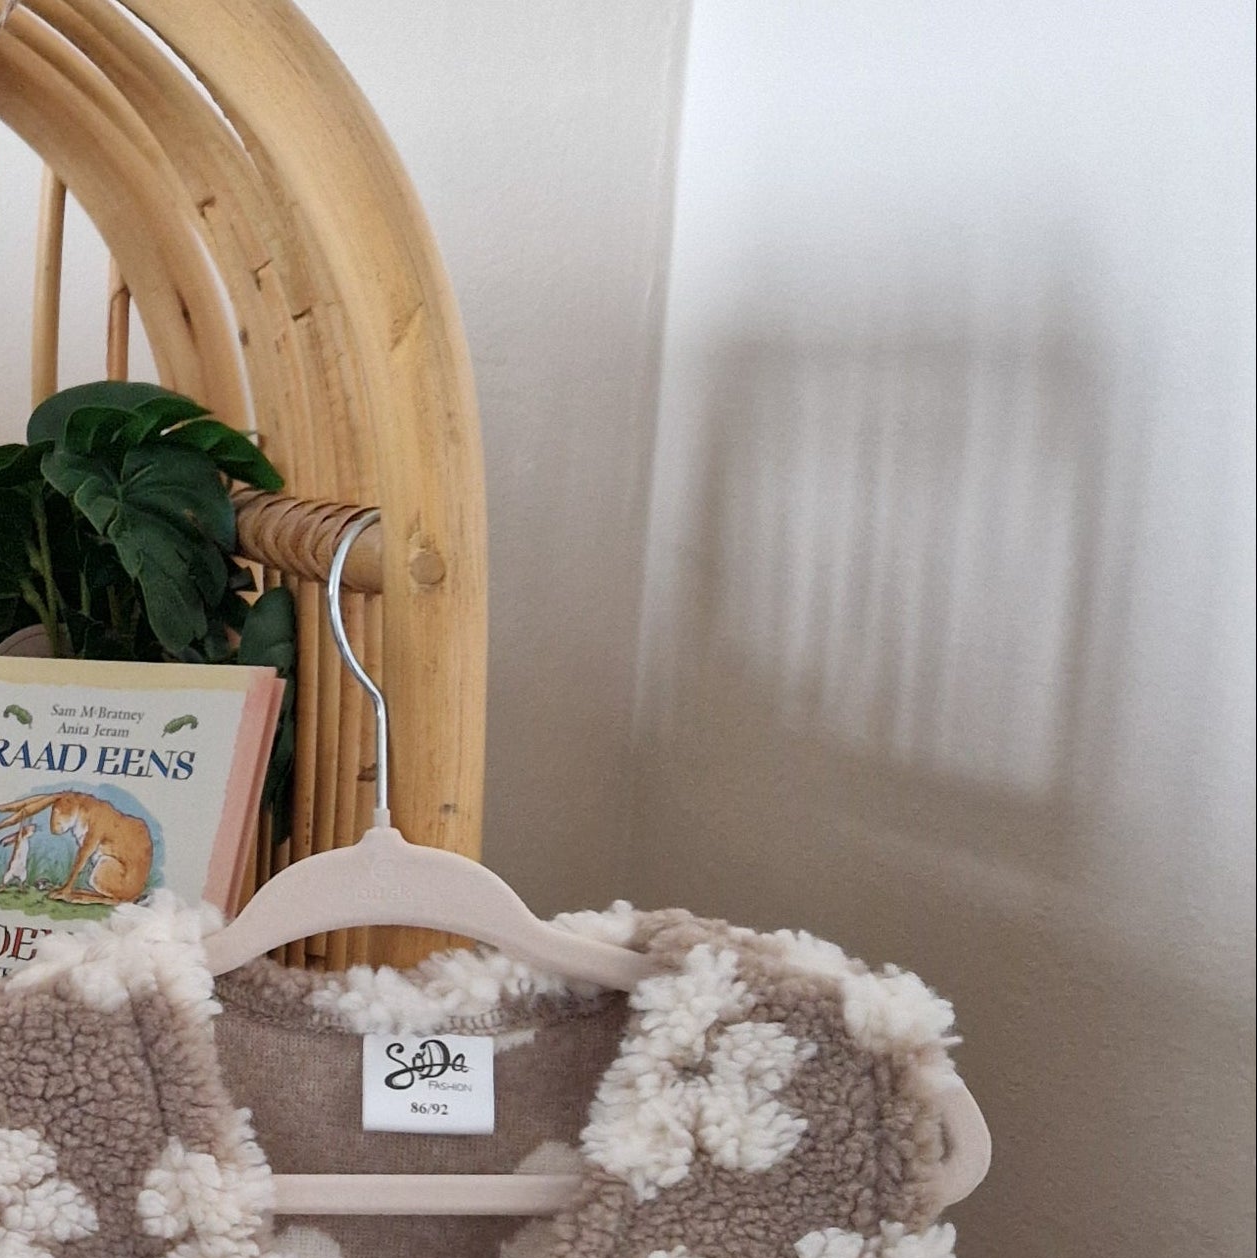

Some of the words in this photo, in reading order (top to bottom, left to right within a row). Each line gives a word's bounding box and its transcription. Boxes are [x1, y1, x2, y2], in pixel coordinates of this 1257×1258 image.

[51, 704, 77, 717] Sam
[57, 722, 89, 735] Anita
[92, 724, 130, 738] Jeram
[93, 746, 196, 780] EENS
[428, 1080, 472, 1092] FASHION
[410, 1102, 449, 1116] 86/92
